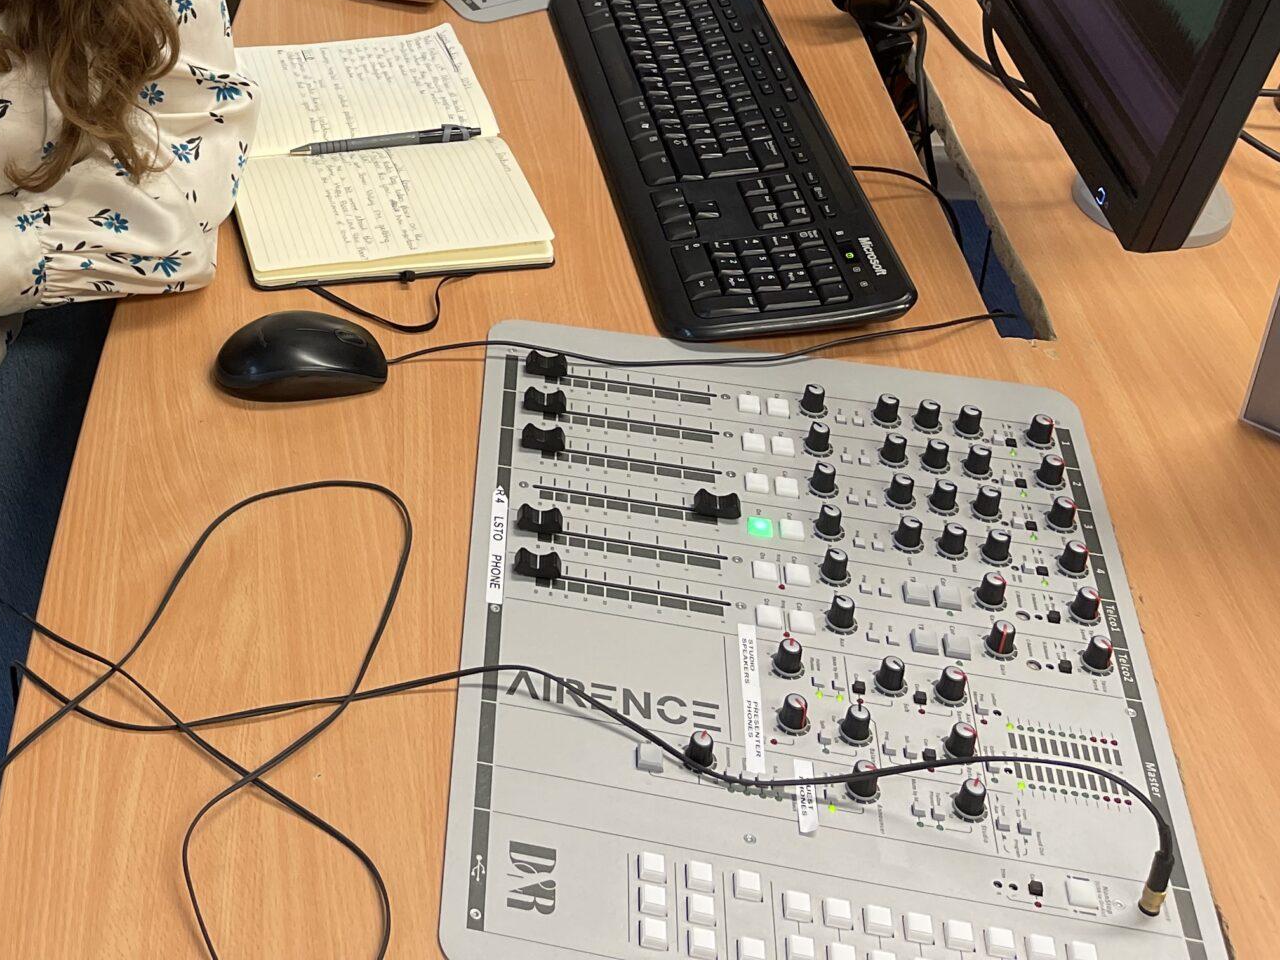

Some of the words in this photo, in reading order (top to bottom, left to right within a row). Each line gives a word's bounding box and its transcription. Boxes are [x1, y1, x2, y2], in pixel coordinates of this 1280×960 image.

[857, 236, 888, 276] Microsoft
[493, 516, 504, 541] LSTO
[490, 554, 501, 589] PHONE
[1104, 604, 1121, 633] Telco1
[742, 638, 750, 684] SPEAKERS
[1118, 654, 1133, 682] Telco2
[506, 670, 721, 732] AIRENCE
[753, 701, 762, 758] PRESENTER
[1145, 762, 1162, 798] Master
